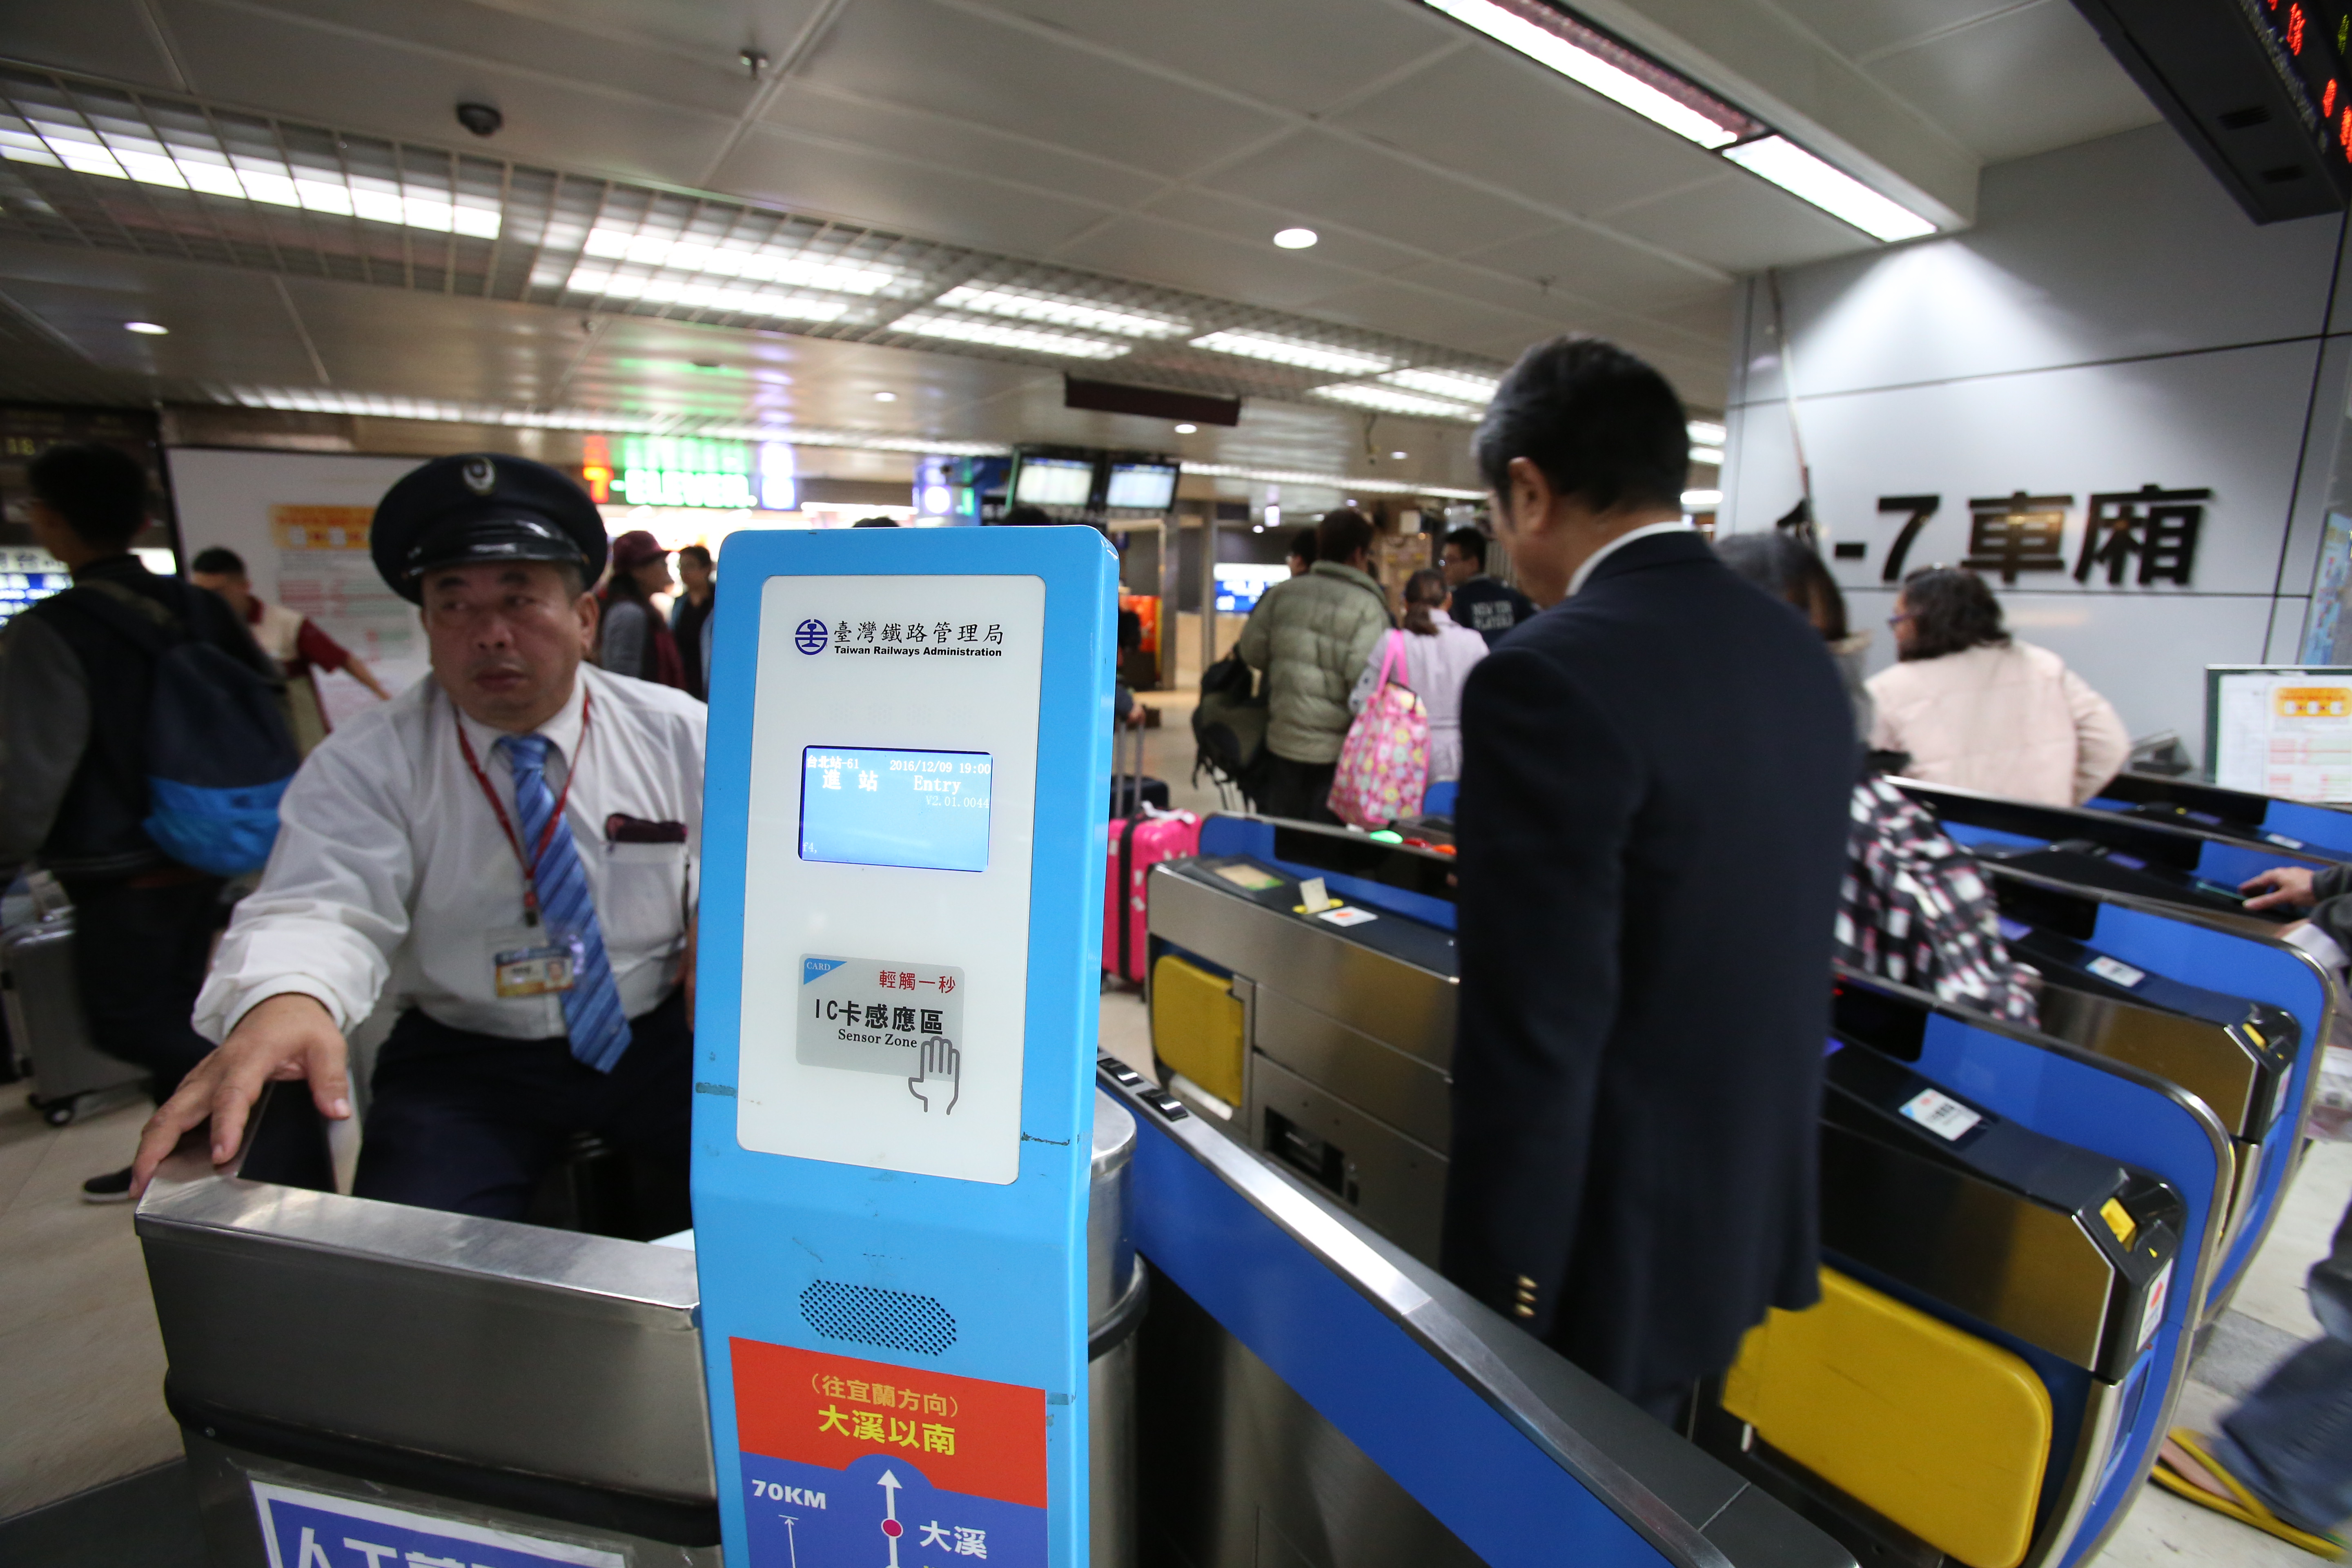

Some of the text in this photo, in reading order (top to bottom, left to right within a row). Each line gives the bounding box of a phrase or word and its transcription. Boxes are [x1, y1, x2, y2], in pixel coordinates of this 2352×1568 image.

[834, 620, 1003, 645] 臺灣鐵路管理局
[834, 646, 1002, 657] Taiwan Railways Administration
[807, 755, 991, 775] 台北站-61 2016/12/09 19:00
[913, 775, 962, 795] Entry
[926, 795, 990, 808] V2.01.0044
[806, 961, 831, 971] CARD
[879, 970, 956, 993] 輕觸一秒
[815, 999, 943, 1035] IC卡感應區
[838, 1029, 918, 1048] Sensor Zone
[818, 1404, 956, 1456] 大溪以南
[751, 1479, 827, 1510] 70KM
[919, 1519, 988, 1560] 大溪
